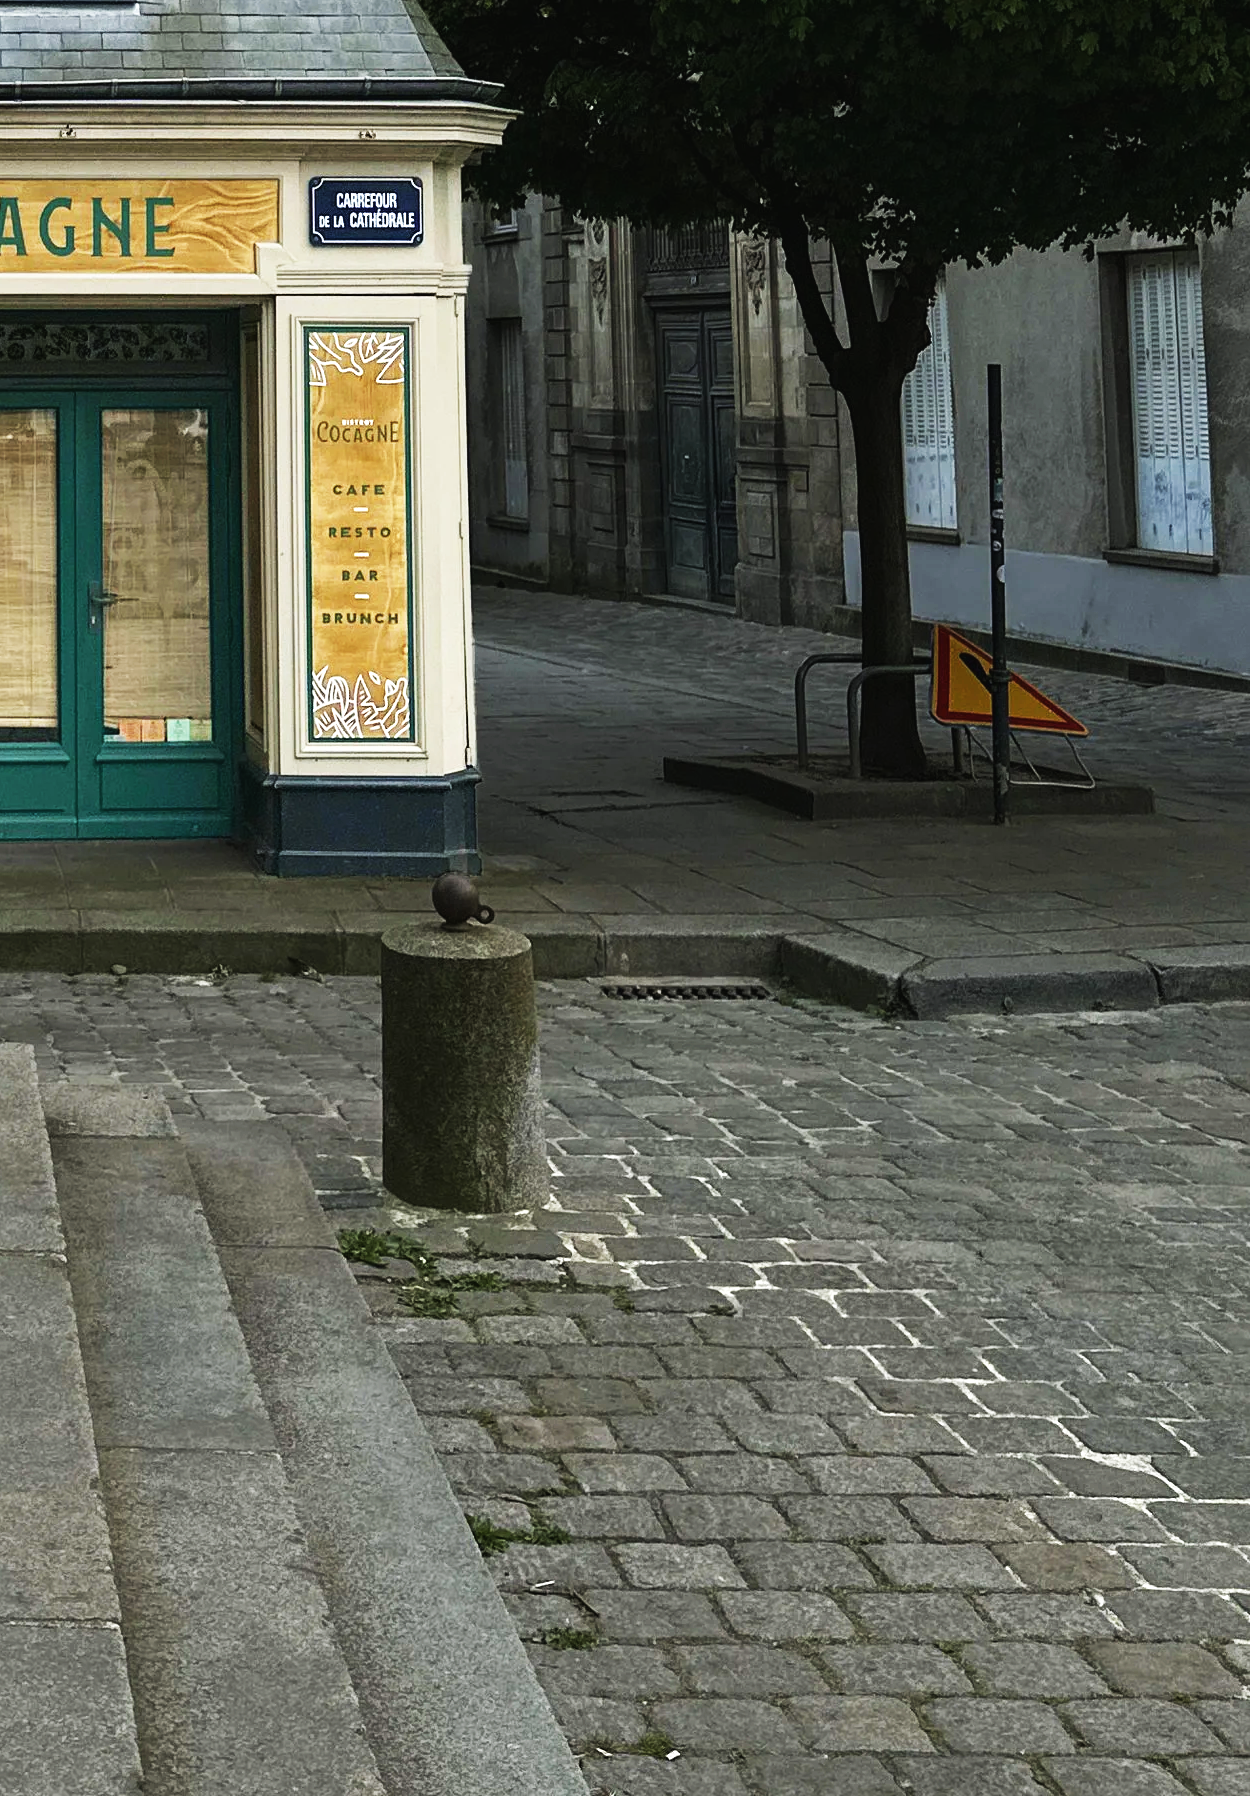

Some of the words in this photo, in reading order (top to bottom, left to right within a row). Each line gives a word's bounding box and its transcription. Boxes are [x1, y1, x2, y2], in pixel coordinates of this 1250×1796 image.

[336, 192, 397, 208] CARREFOUR
[319, 215, 330, 227] DE
[333, 215, 345, 227] LA
[350, 208, 415, 228] CATHÉDRALE
[317, 420, 399, 443] COCAGNE
[333, 485, 385, 495] CAFE
[328, 527, 391, 538] RESTO
[341, 570, 379, 581] BAR
[322, 613, 399, 624] BRUNCH
